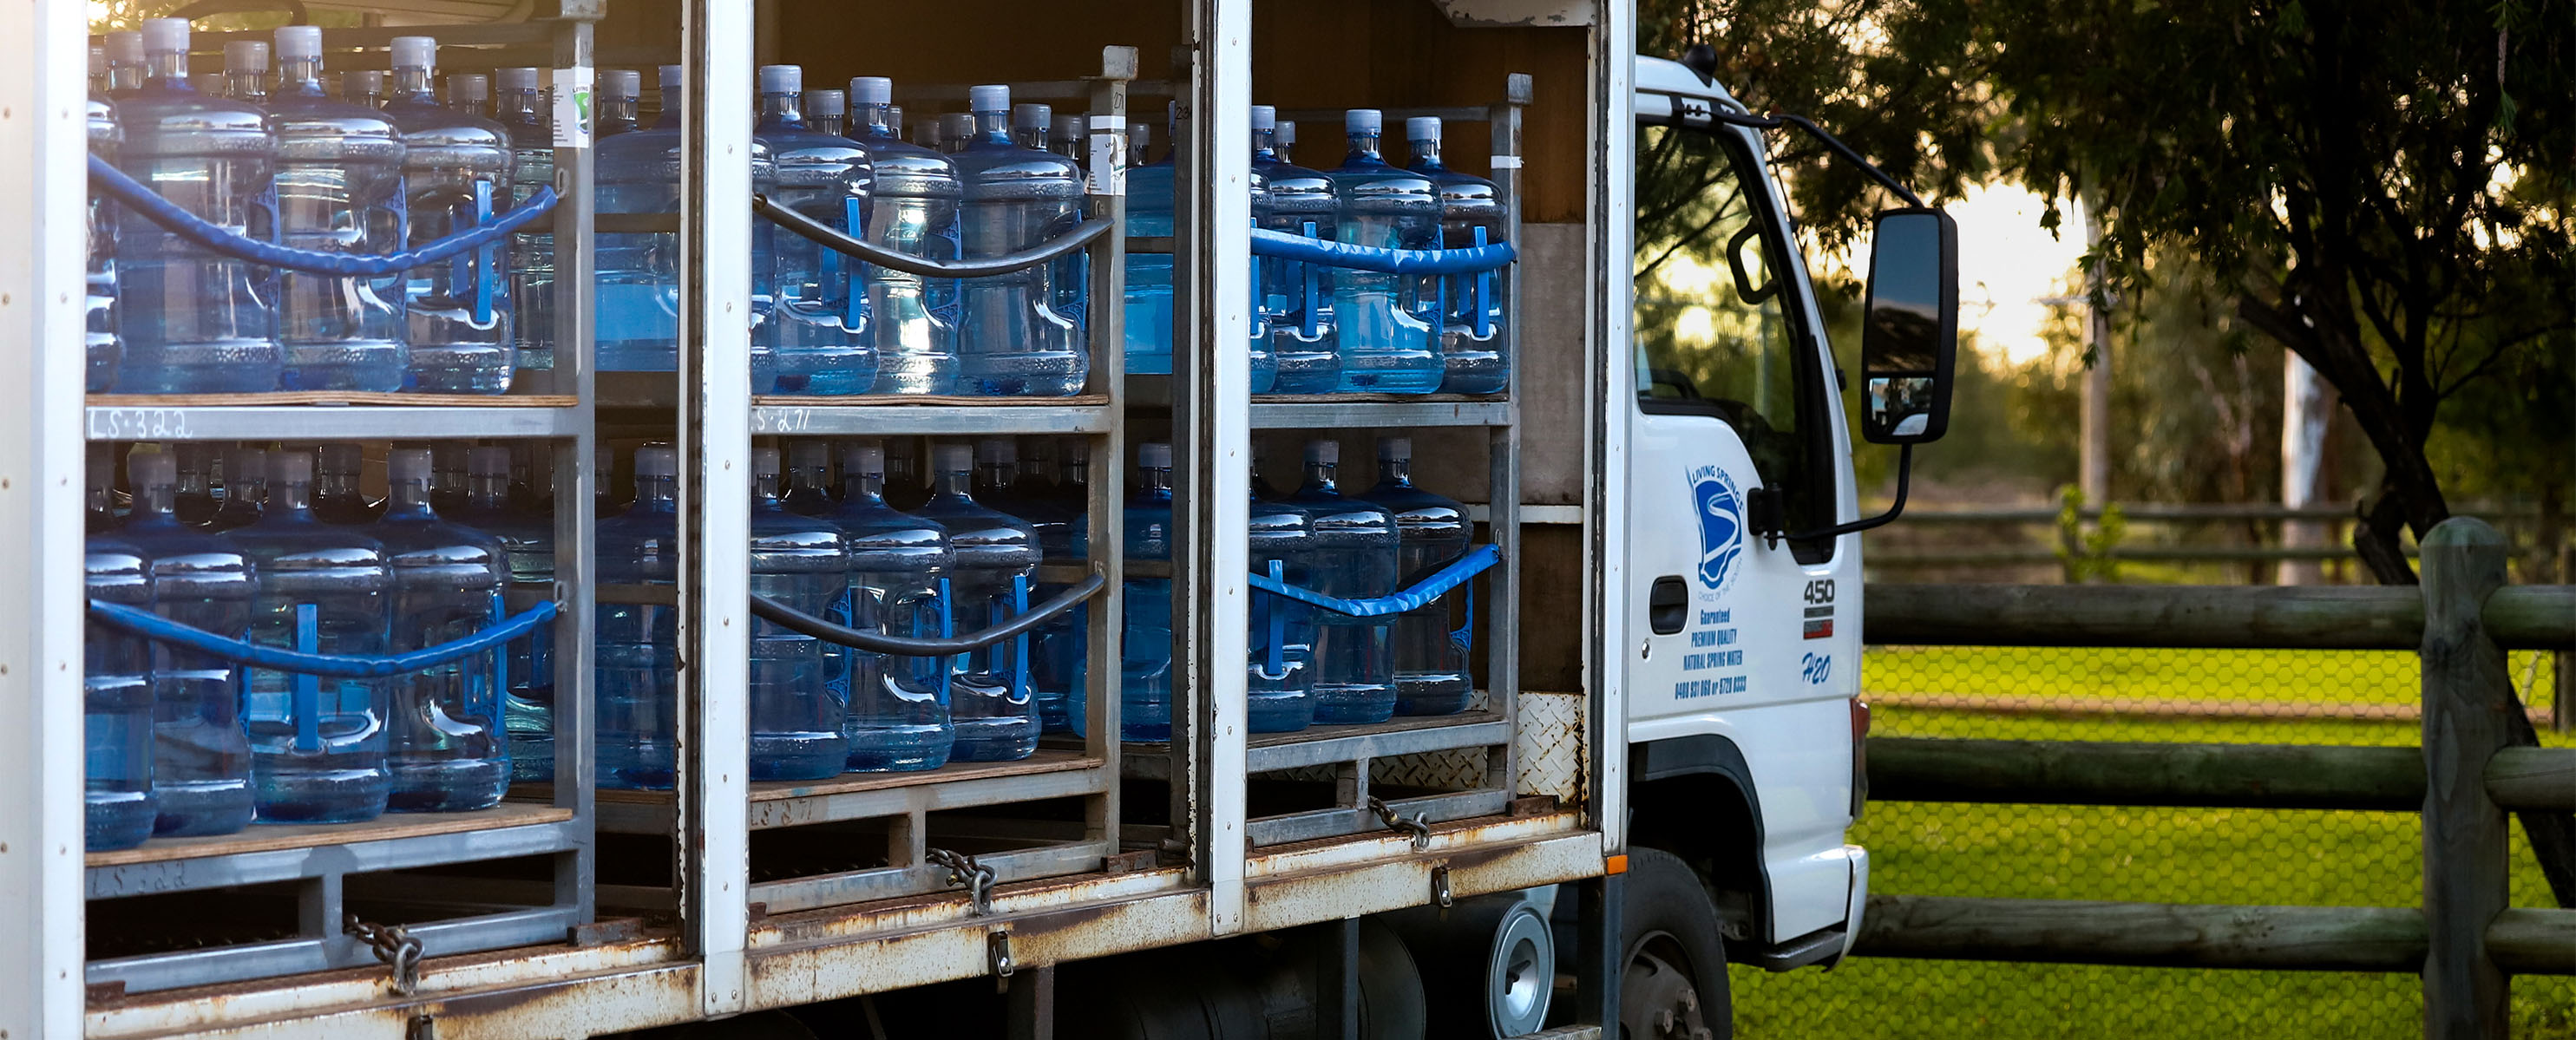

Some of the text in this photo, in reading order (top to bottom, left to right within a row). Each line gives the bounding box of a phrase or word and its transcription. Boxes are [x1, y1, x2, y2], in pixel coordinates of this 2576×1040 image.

[1692, 465, 1743, 511] LIVING SPRINGS
[1804, 579, 1835, 605] 450
[1701, 607, 1731, 625] Guaranteed
[1691, 628, 1737, 648] PREMIUM QUALITY
[1683, 649, 1743, 671] NATURAL SPRING WATER
[1711, 682, 1719, 696] or
